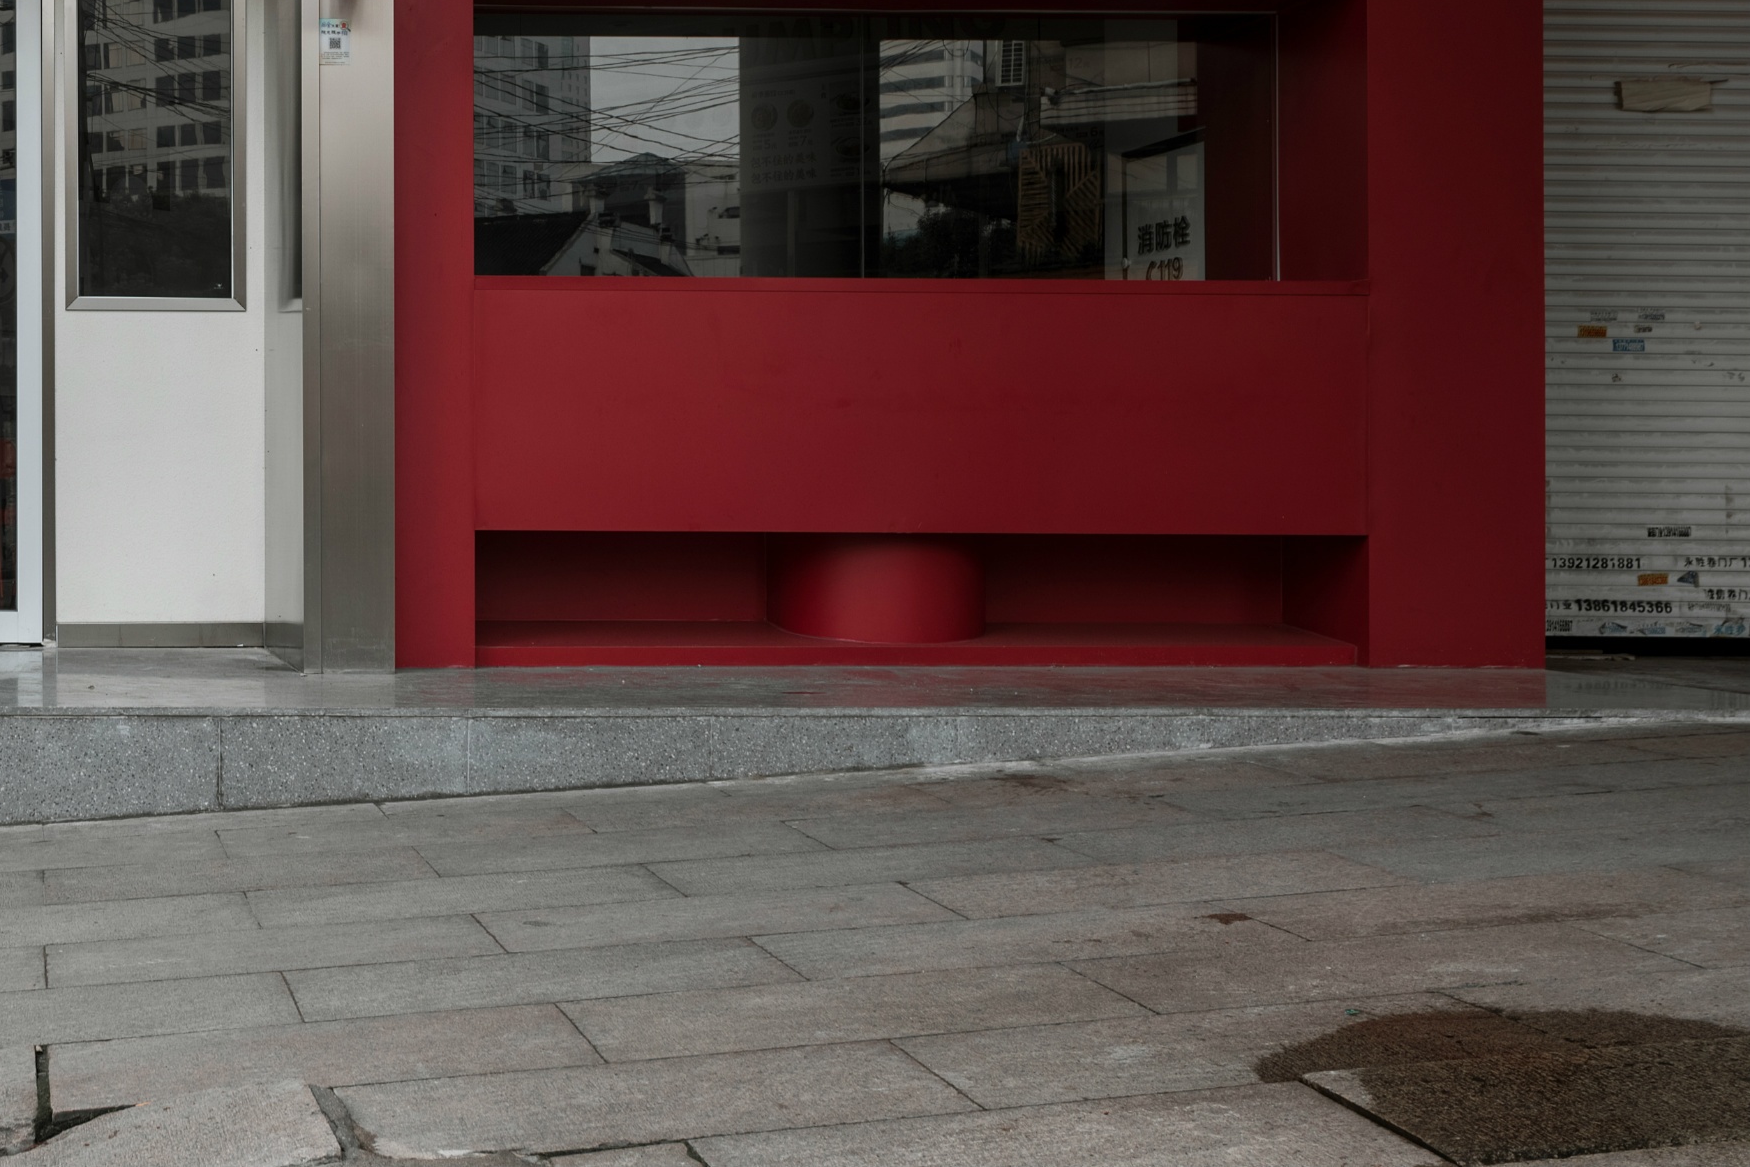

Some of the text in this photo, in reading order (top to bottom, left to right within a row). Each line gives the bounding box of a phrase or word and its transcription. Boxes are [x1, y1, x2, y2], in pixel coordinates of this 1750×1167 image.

[1138, 215, 1190, 254] 消防栓
[1552, 557, 1640, 569] 13921281881
[1575, 598, 1673, 614] 13861845366
